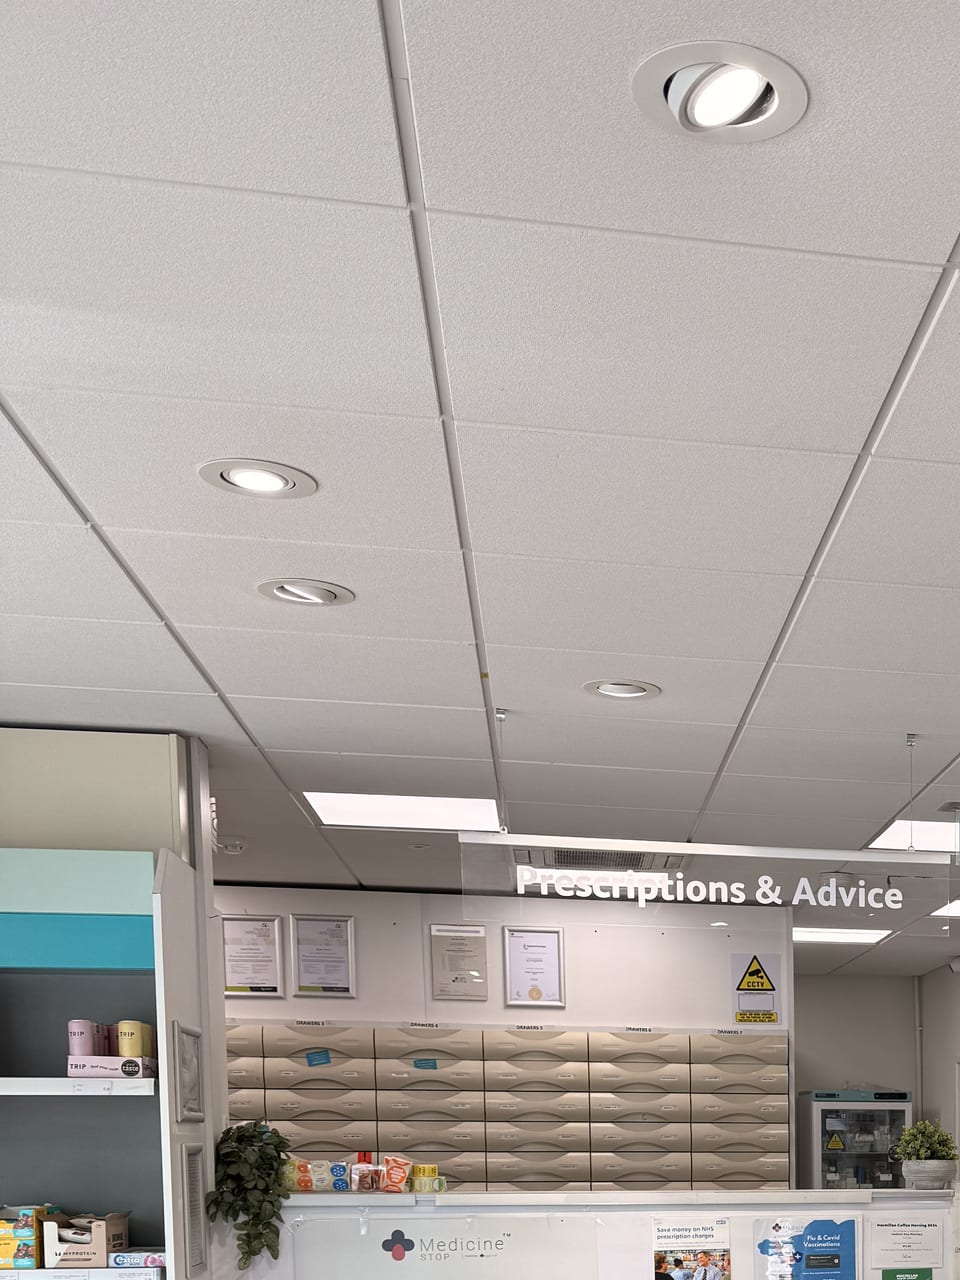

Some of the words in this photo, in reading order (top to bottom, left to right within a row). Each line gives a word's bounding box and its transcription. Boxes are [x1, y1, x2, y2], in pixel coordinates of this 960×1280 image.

[516, 864, 746, 907] Prescriptions
[755, 875, 783, 905] &
[791, 876, 903, 909] Advice
[420, 1237, 504, 1252] Medicine
[420, 1253, 450, 1261] STOP
